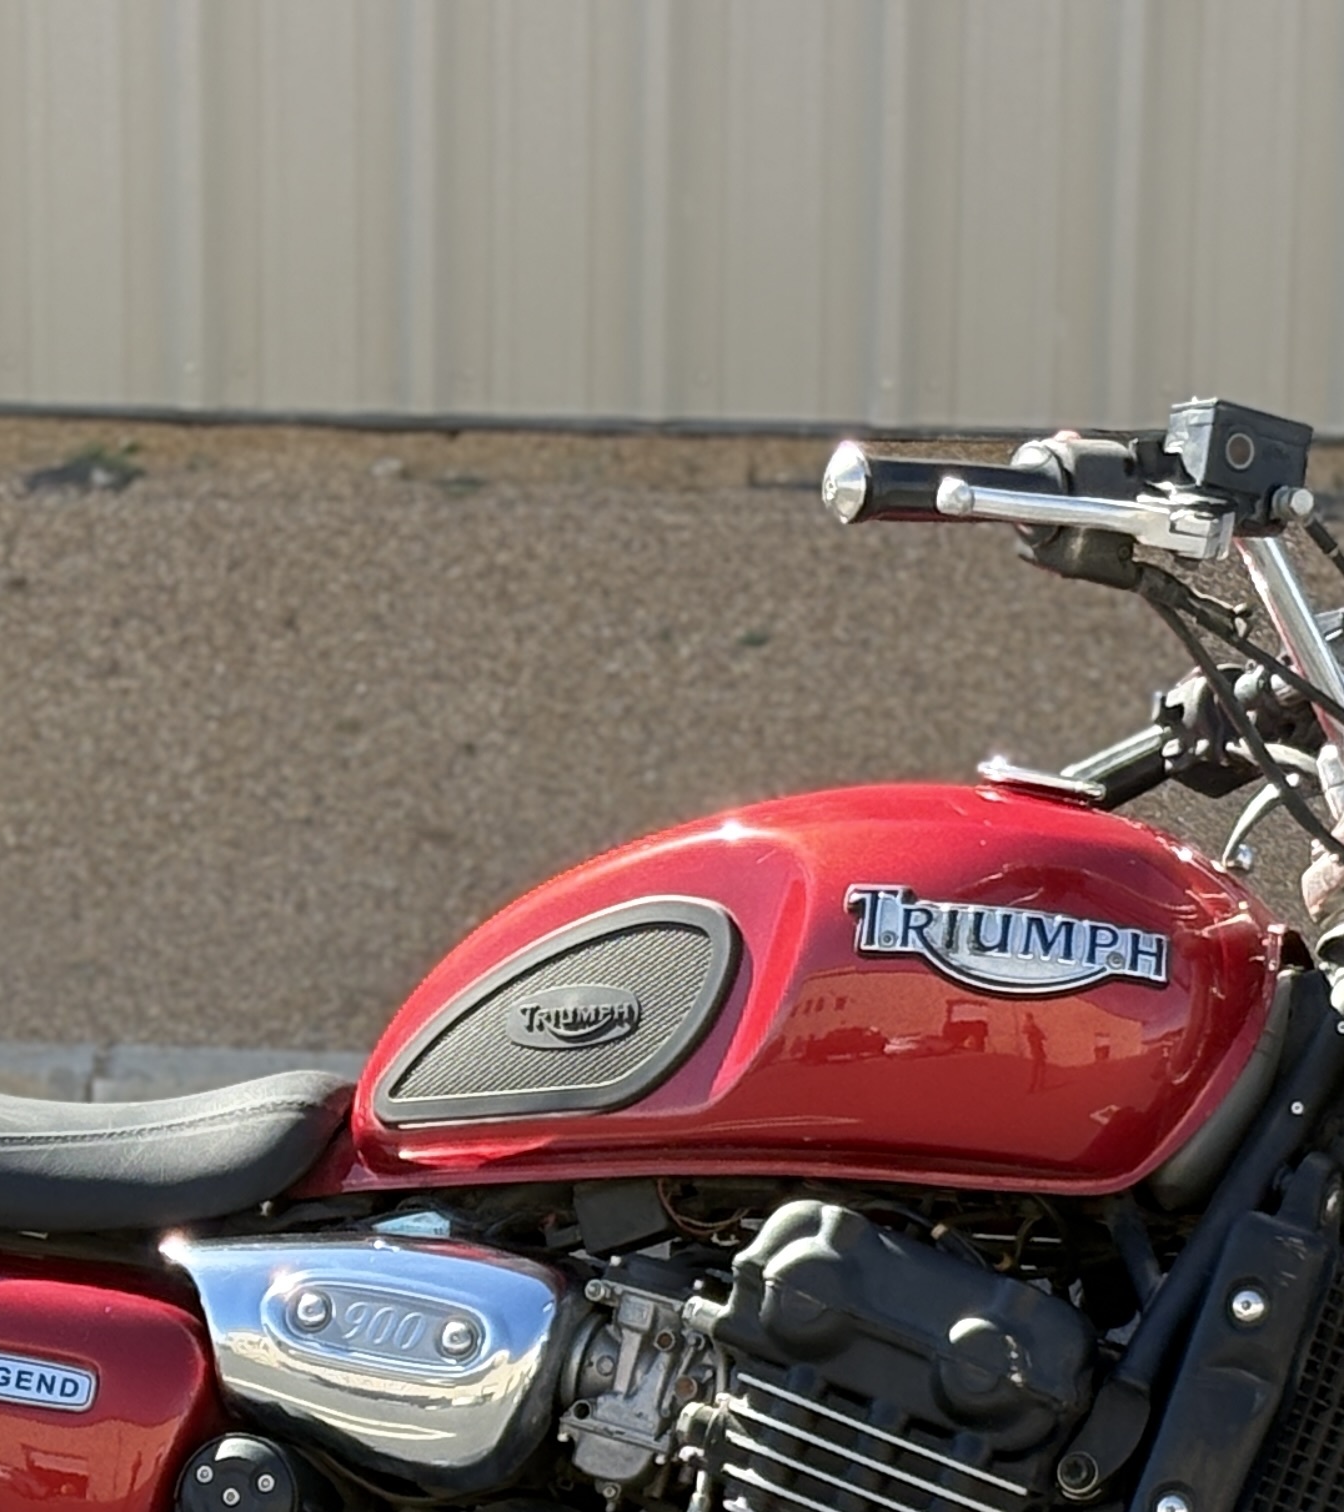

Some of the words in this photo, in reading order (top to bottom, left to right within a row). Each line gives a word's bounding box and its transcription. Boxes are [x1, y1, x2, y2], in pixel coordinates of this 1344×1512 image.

[847, 886, 1170, 979] TRIUMPH
[519, 1003, 634, 1035] TRIUMPH
[342, 1301, 427, 1350] 900
